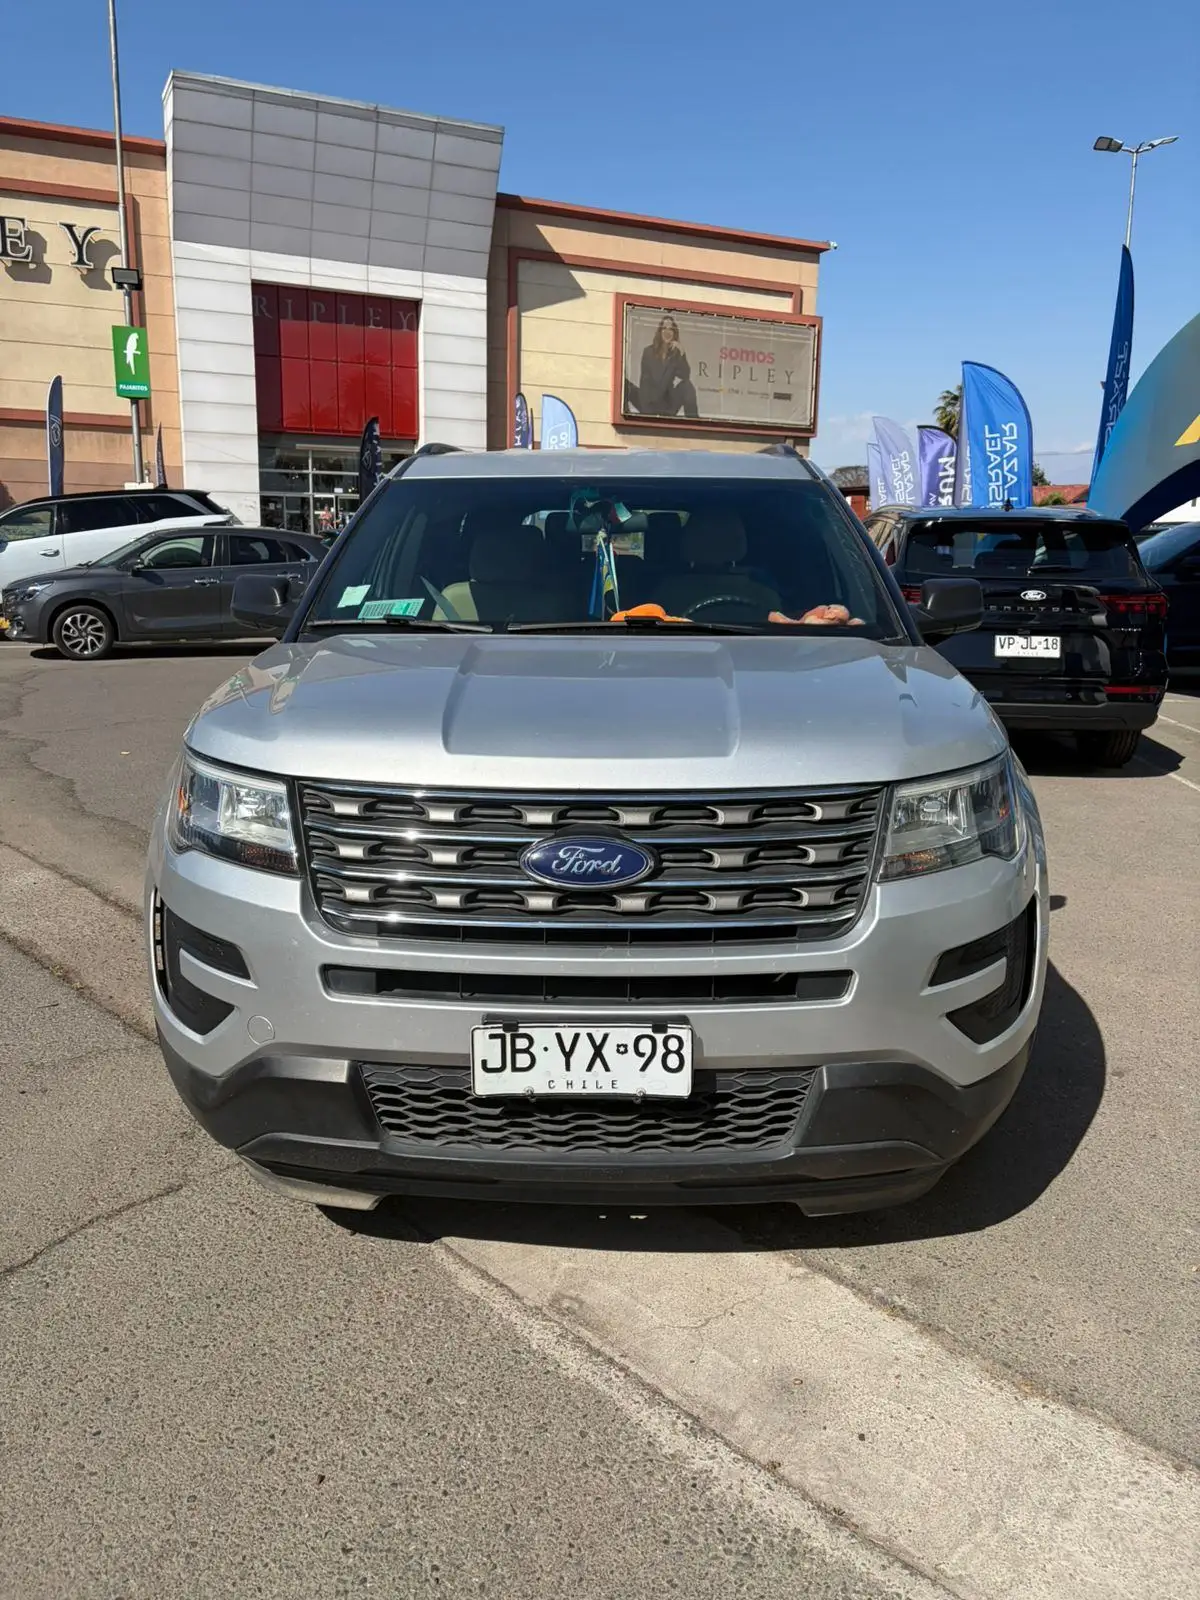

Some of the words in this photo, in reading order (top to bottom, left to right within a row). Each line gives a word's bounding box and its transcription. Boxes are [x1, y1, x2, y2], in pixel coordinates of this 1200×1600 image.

[252, 294, 416, 331] RIPLEY
[719, 346, 775, 365] somos
[698, 361, 795, 385] RIPLEY
[986, 604, 1088, 613] ERRITORY
[551, 845, 624, 876] Ford
[548, 1079, 619, 1090] CHILE
